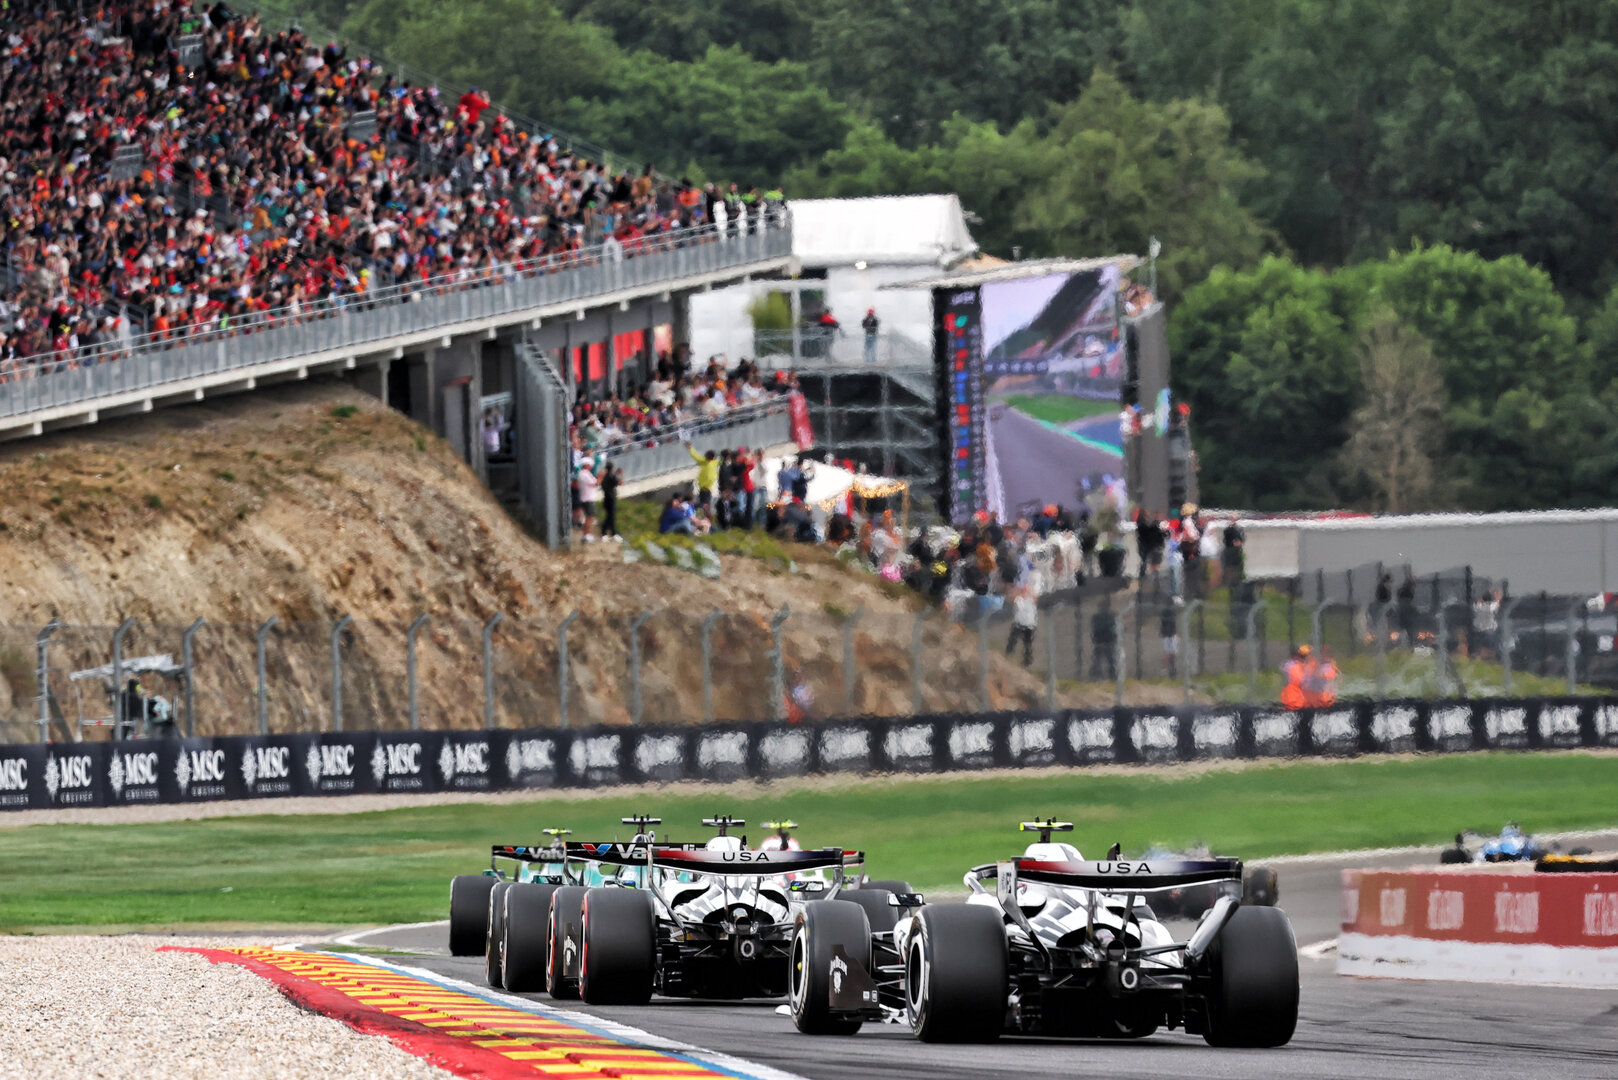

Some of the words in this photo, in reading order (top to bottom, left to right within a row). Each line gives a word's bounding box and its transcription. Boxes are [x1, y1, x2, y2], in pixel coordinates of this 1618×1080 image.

[60, 756, 92, 788] MSC
[125, 752, 158, 785] MSC
[191, 750, 226, 781] MSC
[257, 747, 289, 778] MSC
[321, 744, 355, 776] MSC
[387, 743, 422, 774] MSC
[722, 852, 770, 862] USA
[1096, 862, 1152, 874] USA
